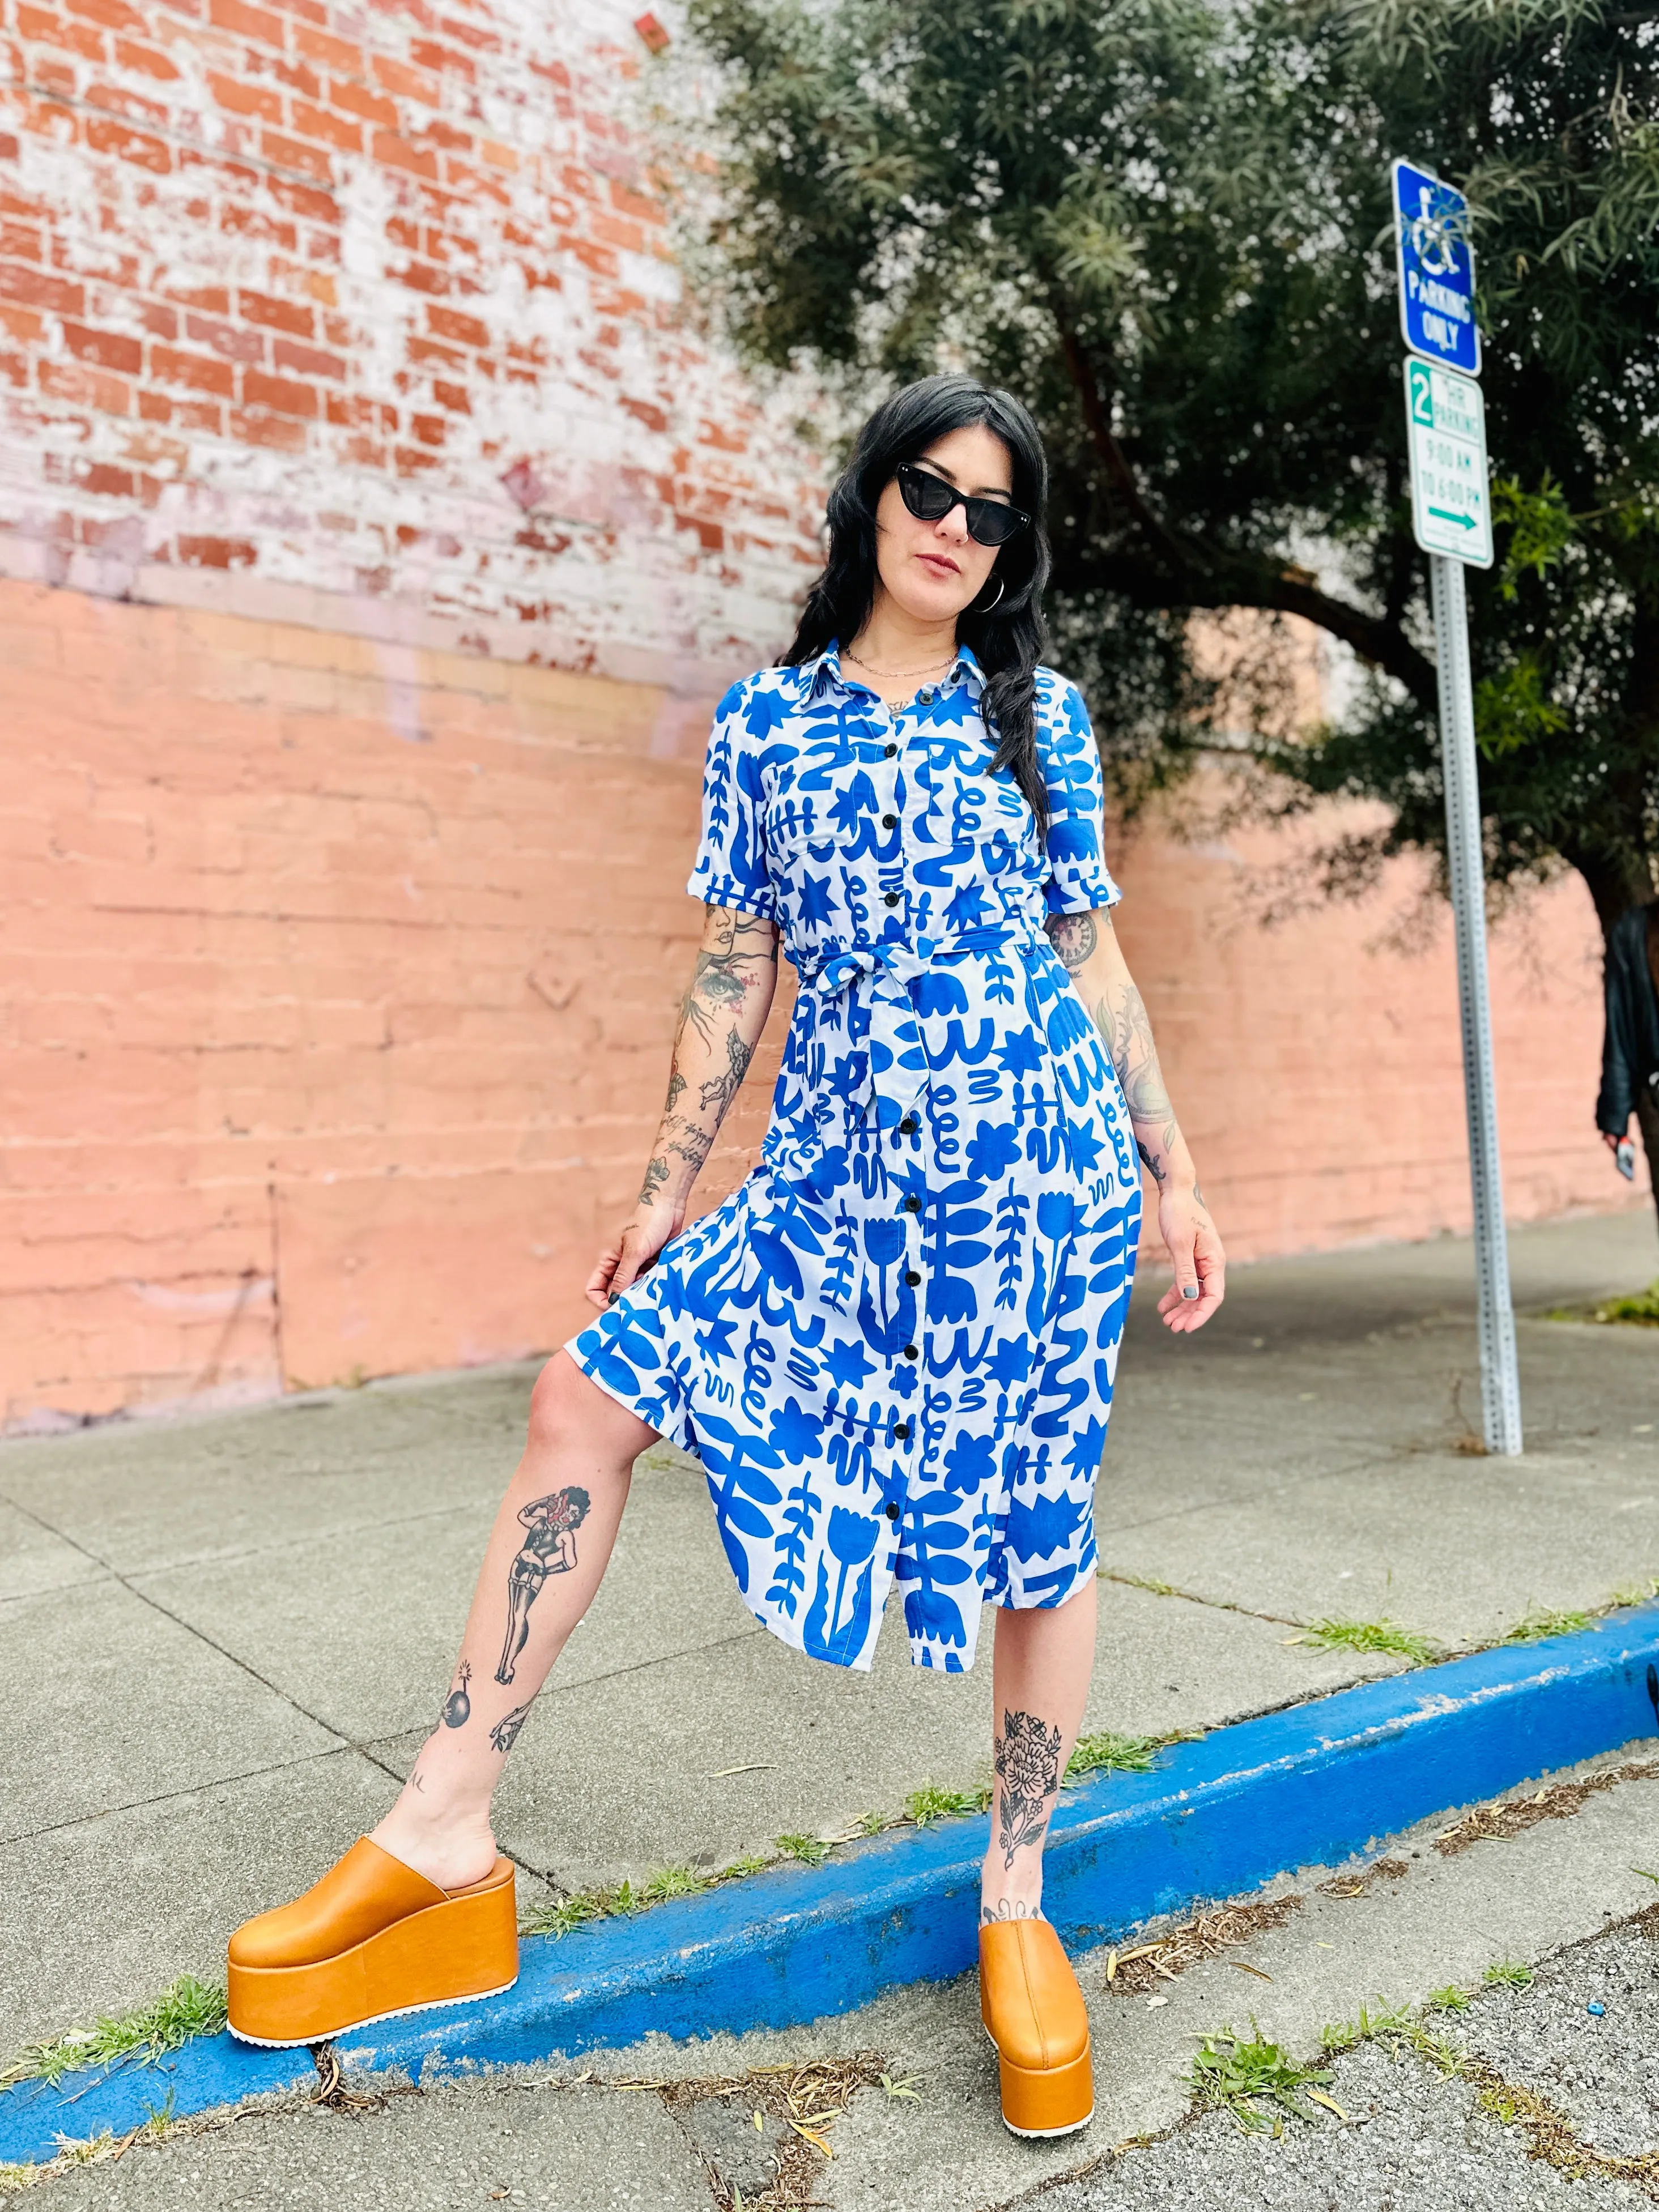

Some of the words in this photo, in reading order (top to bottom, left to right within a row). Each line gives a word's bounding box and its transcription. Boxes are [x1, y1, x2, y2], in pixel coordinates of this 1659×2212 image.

[1407, 270, 1471, 324] PARKING
[1422, 310, 1459, 352] ONLY
[1411, 372, 1432, 421] 2
[1447, 385, 1466, 410] HR
[1434, 401, 1480, 438] PARKING
[1456, 453, 1472, 474] AM
[1422, 471, 1435, 496] TO
[1466, 487, 1482, 511] PM
